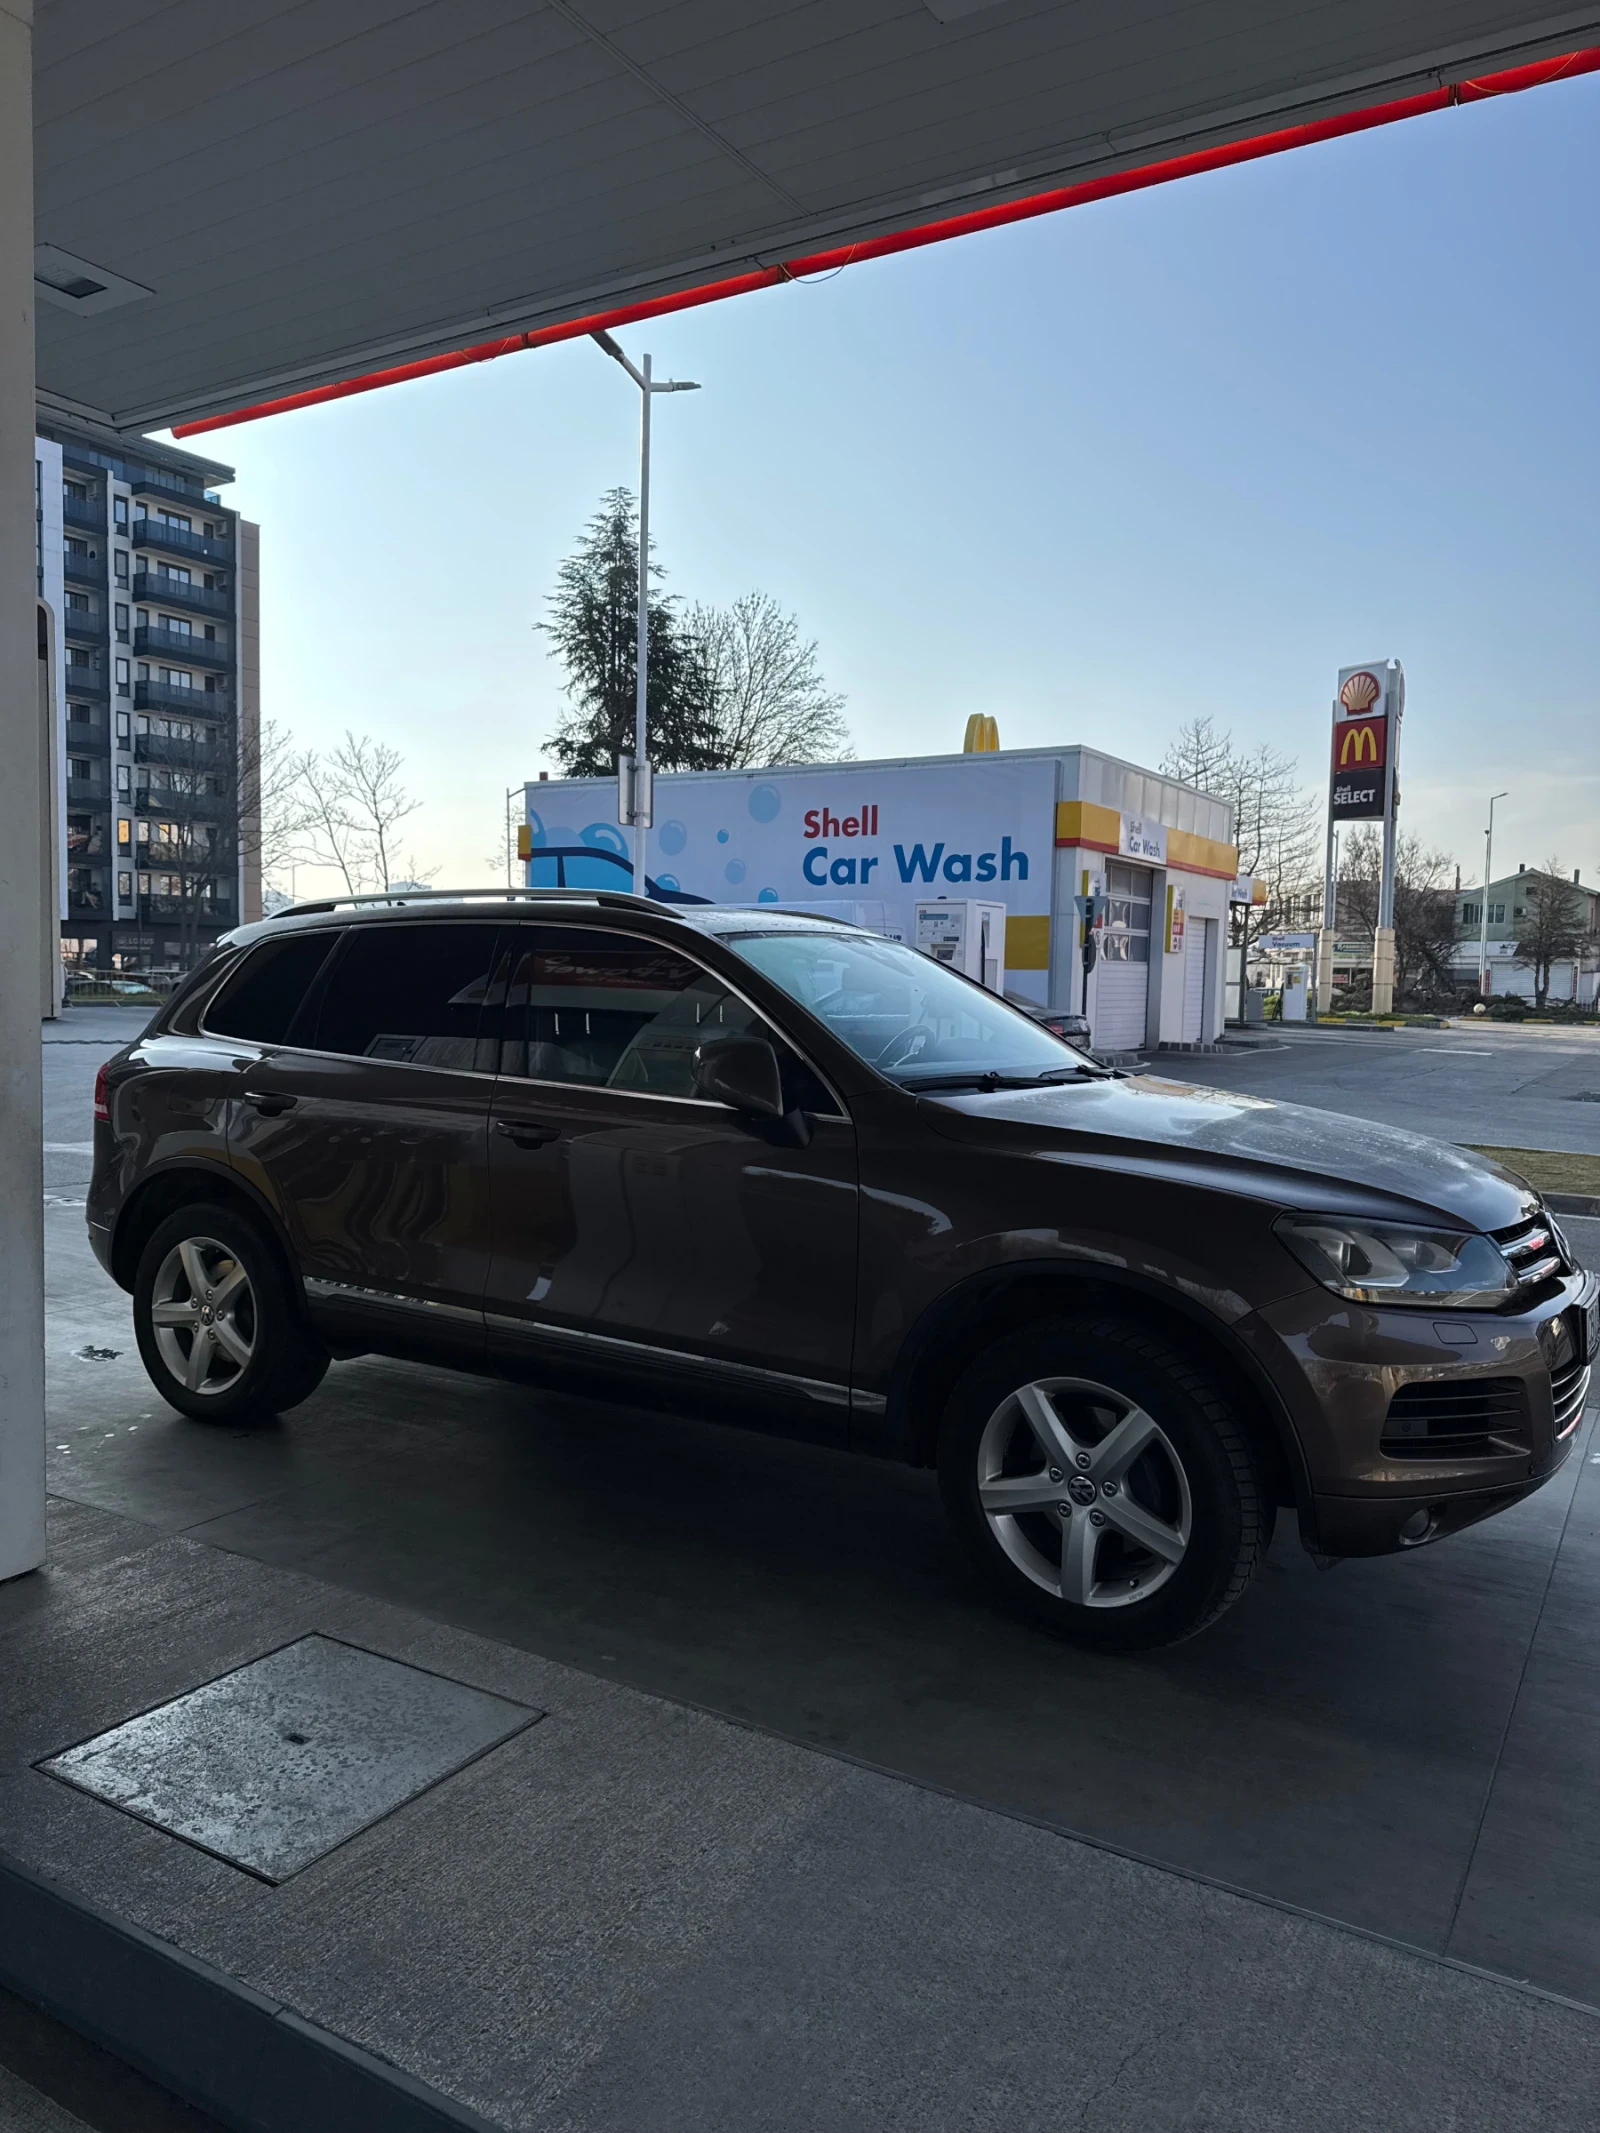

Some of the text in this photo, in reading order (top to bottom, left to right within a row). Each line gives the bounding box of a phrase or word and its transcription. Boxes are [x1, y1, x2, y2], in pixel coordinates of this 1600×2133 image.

[1333, 788, 1375, 804] SELECT
[804, 805, 878, 838] Shell
[1130, 821, 1142, 834] Shell
[1129, 836, 1160, 858] Car Wash
[803, 836, 1029, 885] Car Wash
